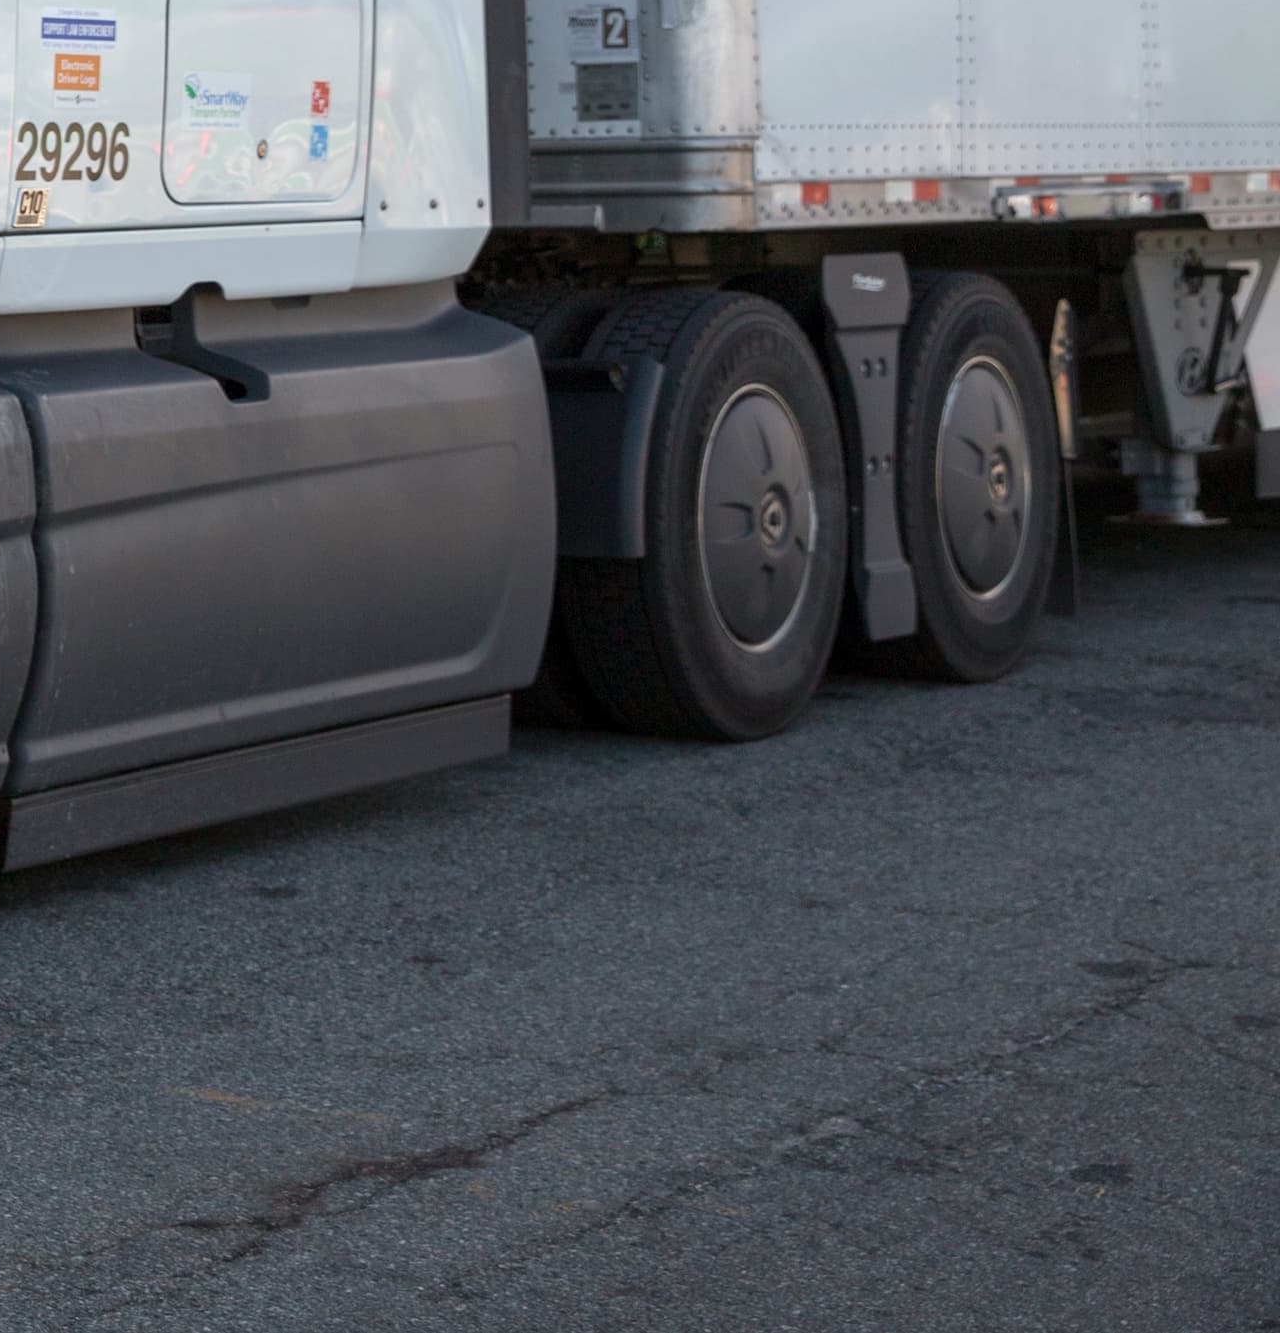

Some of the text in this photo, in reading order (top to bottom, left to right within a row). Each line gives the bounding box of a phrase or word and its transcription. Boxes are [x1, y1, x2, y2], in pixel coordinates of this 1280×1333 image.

[606, 11, 625, 46] 2
[15, 121, 130, 181] 29296
[20, 191, 44, 214] C10
